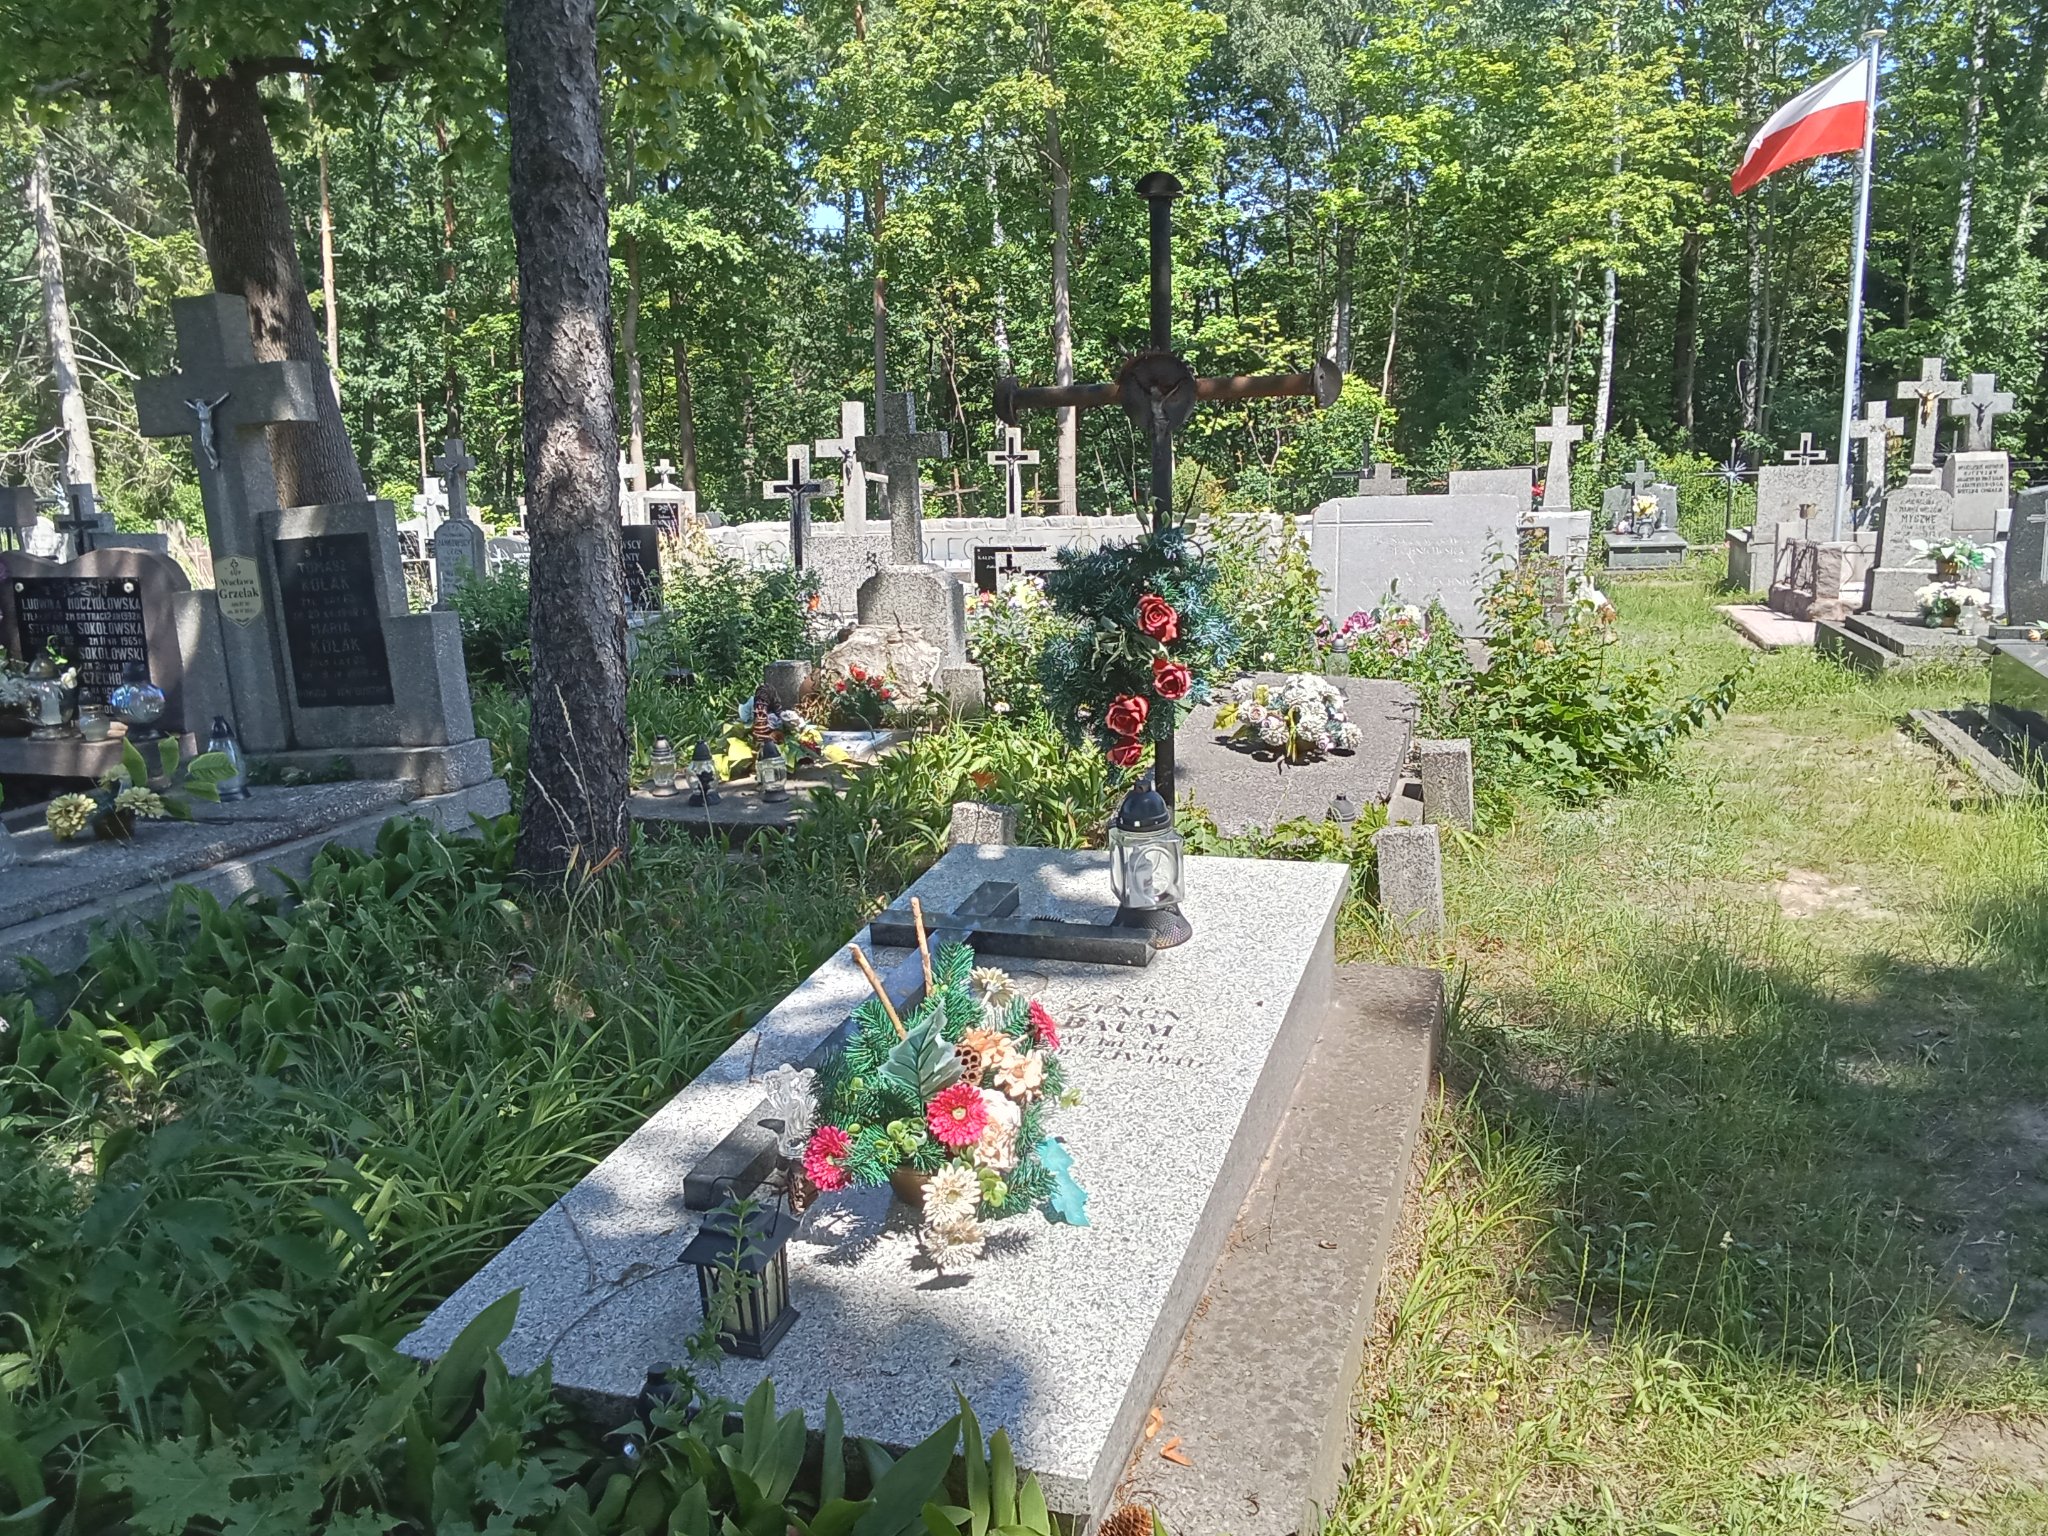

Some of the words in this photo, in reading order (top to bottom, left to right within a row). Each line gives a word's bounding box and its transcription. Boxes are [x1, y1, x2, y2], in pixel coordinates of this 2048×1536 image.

[297, 560, 347, 574] TOMASZ
[219, 587, 260, 599] Grzelak
[77, 622, 143, 635] SOKOŁOWSKA
[311, 622, 352, 636] MARIA
[82, 672, 123, 685] CZECHO
[1064, 1016, 1174, 1037] BAUM
